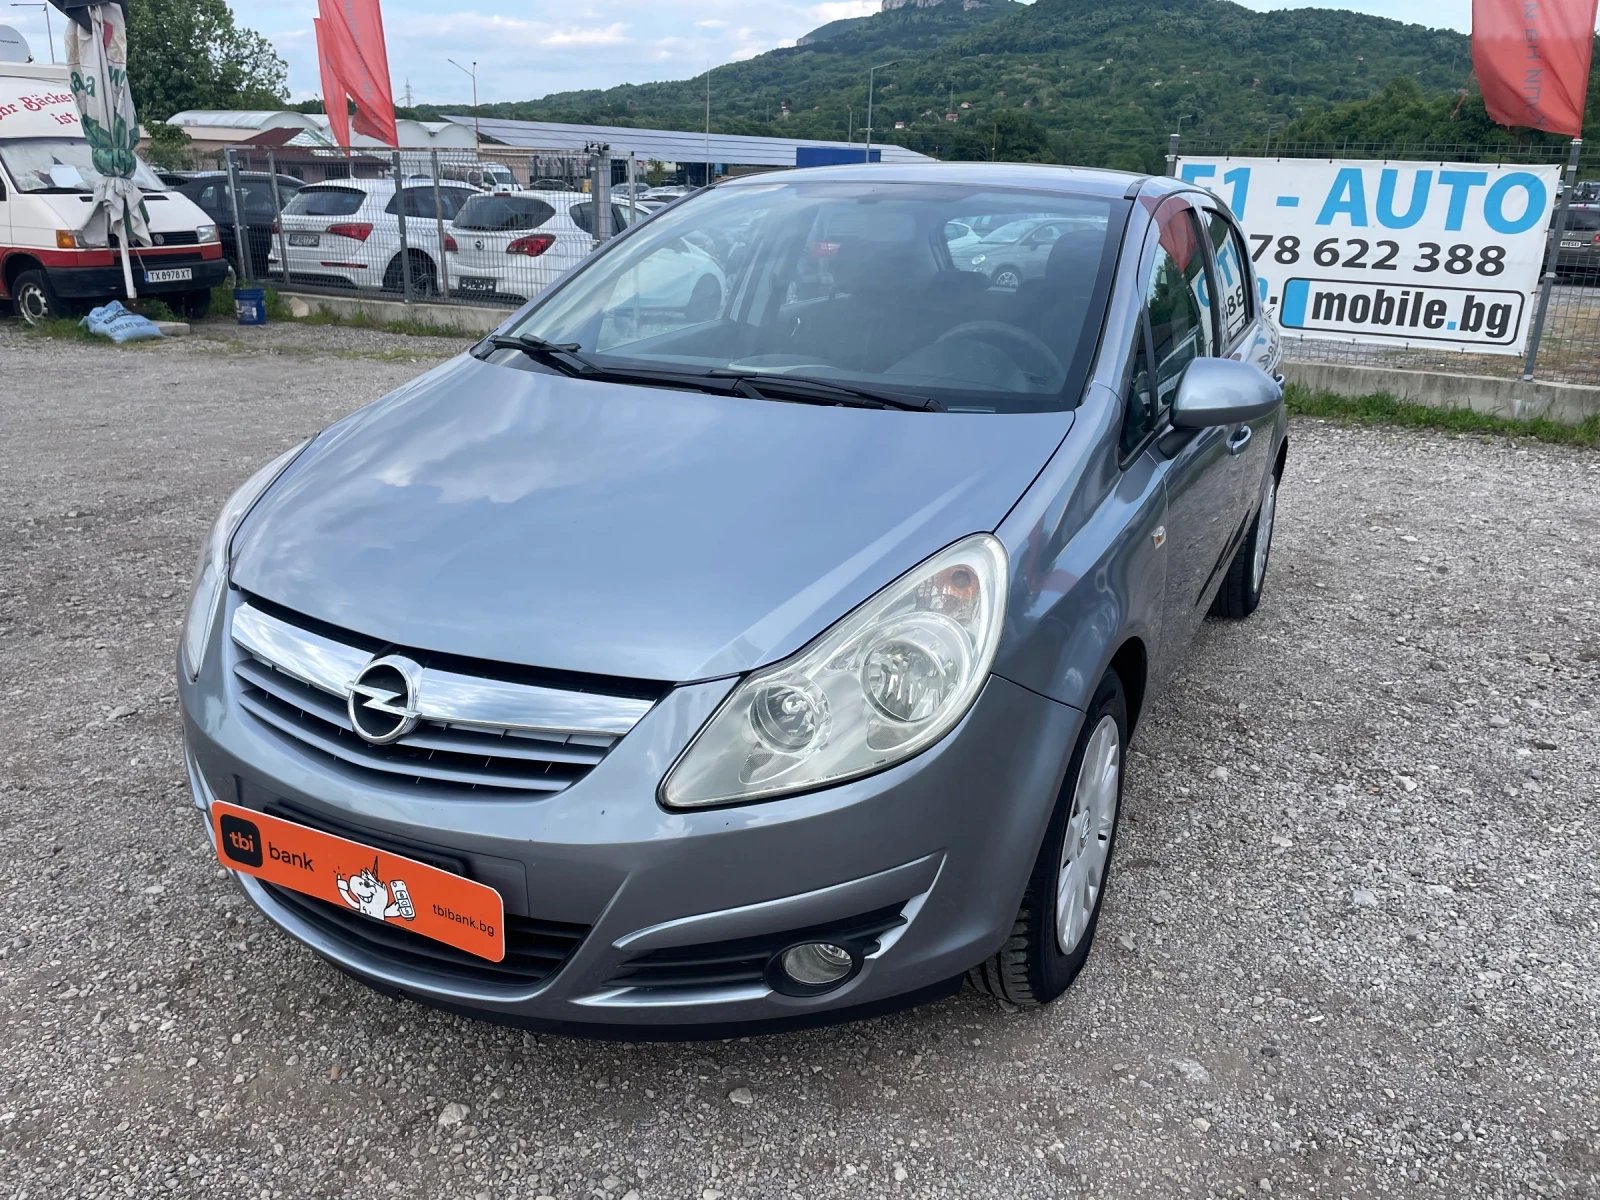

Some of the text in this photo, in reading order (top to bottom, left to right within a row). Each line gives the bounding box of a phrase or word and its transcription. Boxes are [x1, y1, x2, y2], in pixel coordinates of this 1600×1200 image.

[17, 92, 75, 111] Bäcker
[50, 111, 79, 125] ist
[1315, 167, 1547, 235] AUTO
[1313, 237, 1400, 271] 622
[1413, 242, 1506, 277] 388
[1311, 288, 1513, 338] mobile.bg
[229, 831, 314, 872] tbi bank
[432, 903, 495, 937] tbibank.bg
